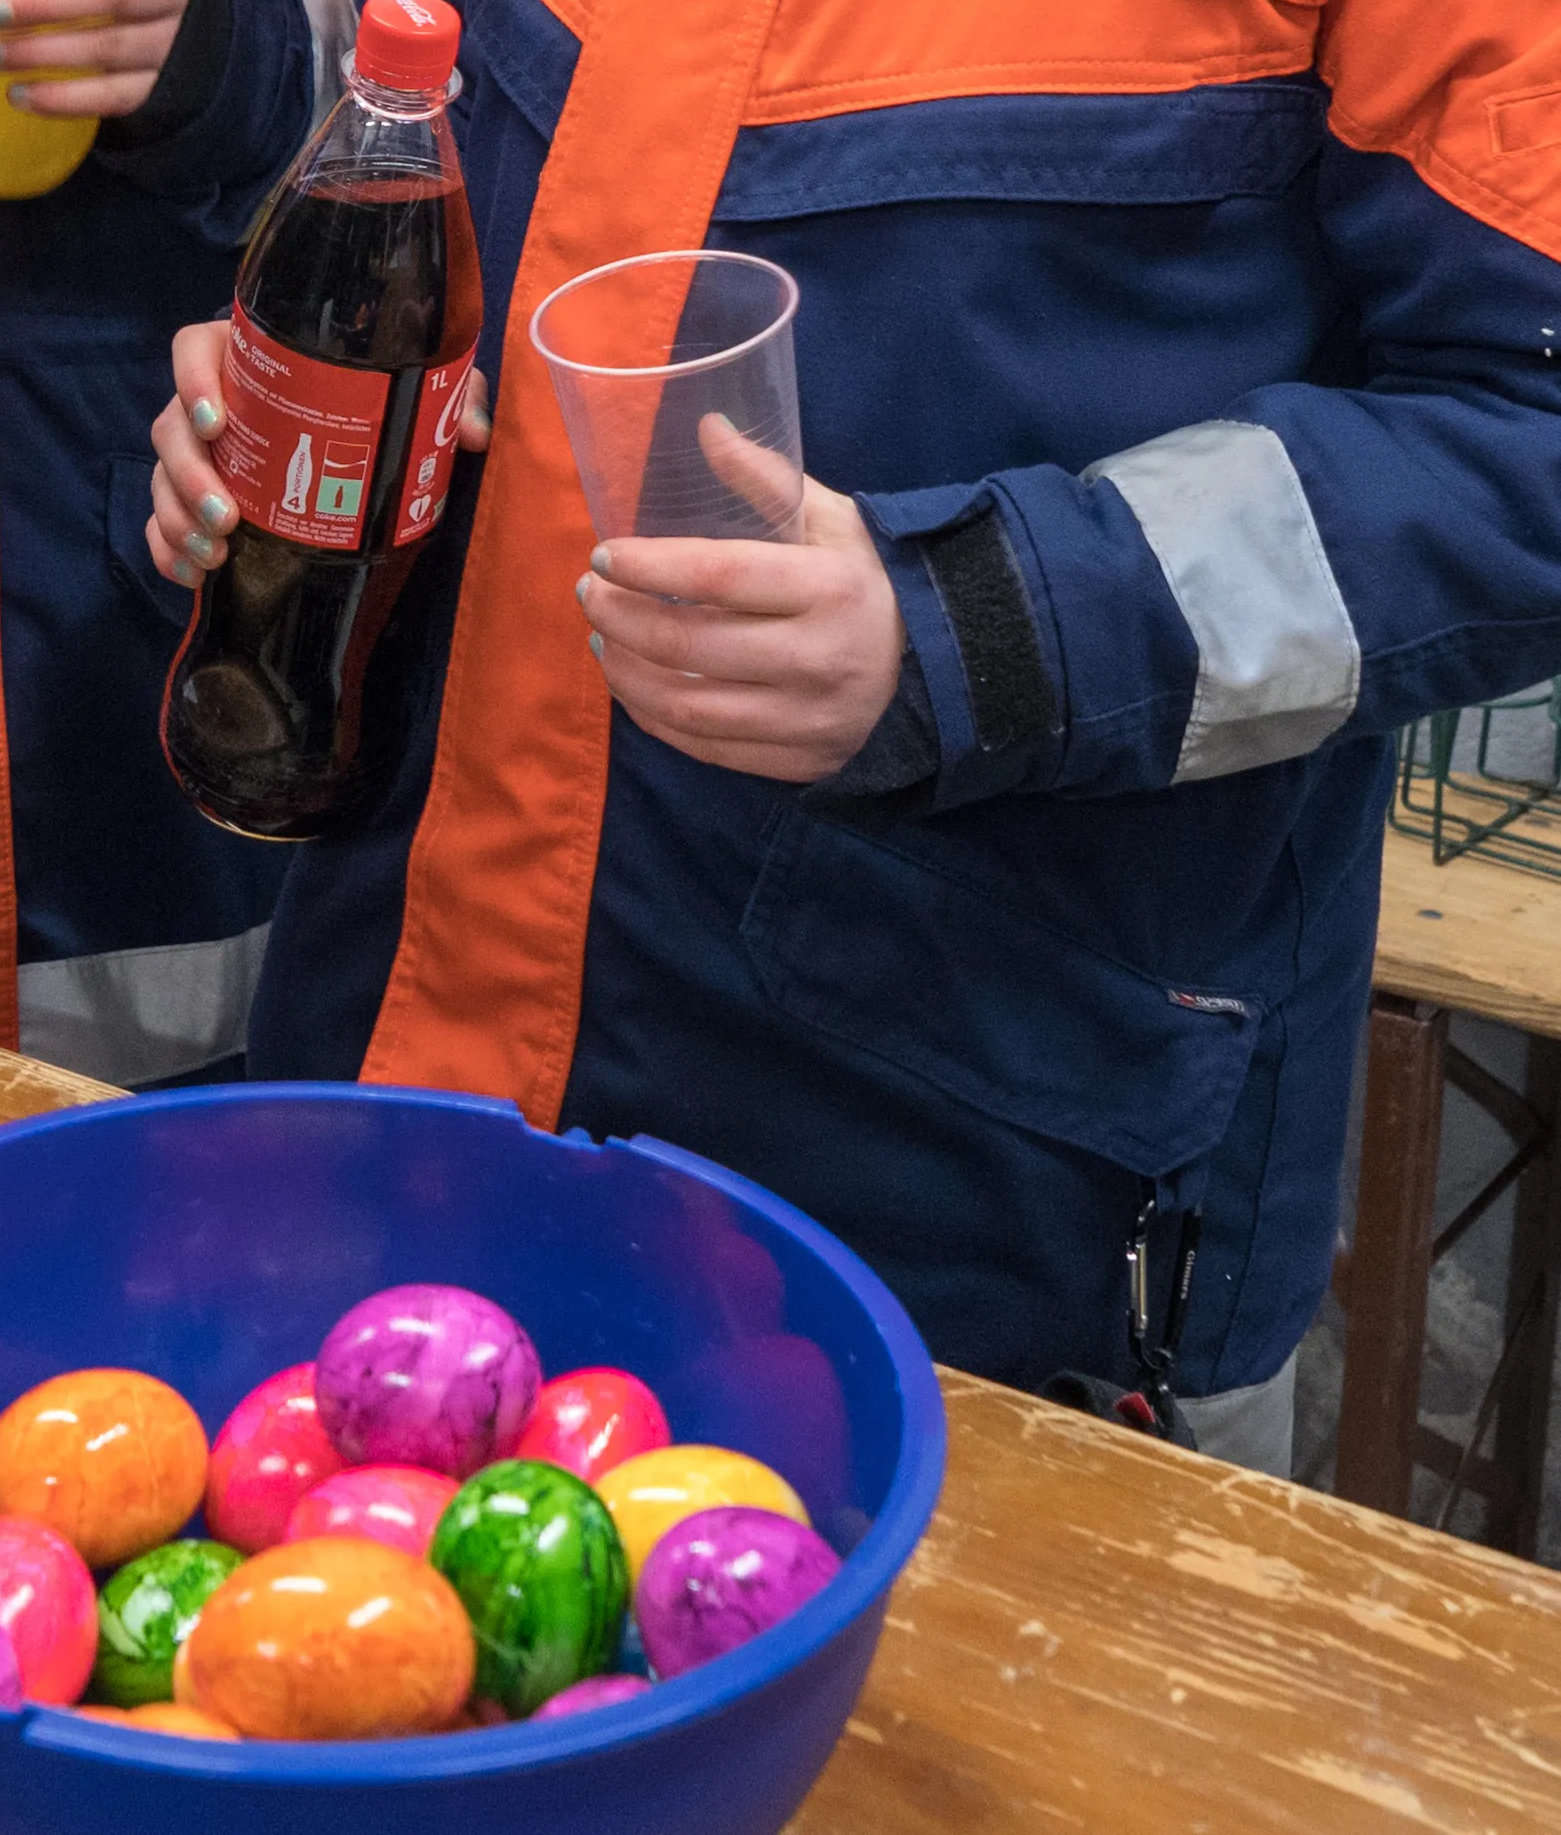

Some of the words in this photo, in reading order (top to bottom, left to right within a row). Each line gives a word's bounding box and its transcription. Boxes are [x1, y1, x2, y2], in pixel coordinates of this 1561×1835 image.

[250, 354, 278, 378] TASTE
[251, 345, 292, 377] ORIGINAL
[431, 370, 448, 391] 1L
[288, 496, 301, 510] 4
[314, 512, 357, 523] coke.com
